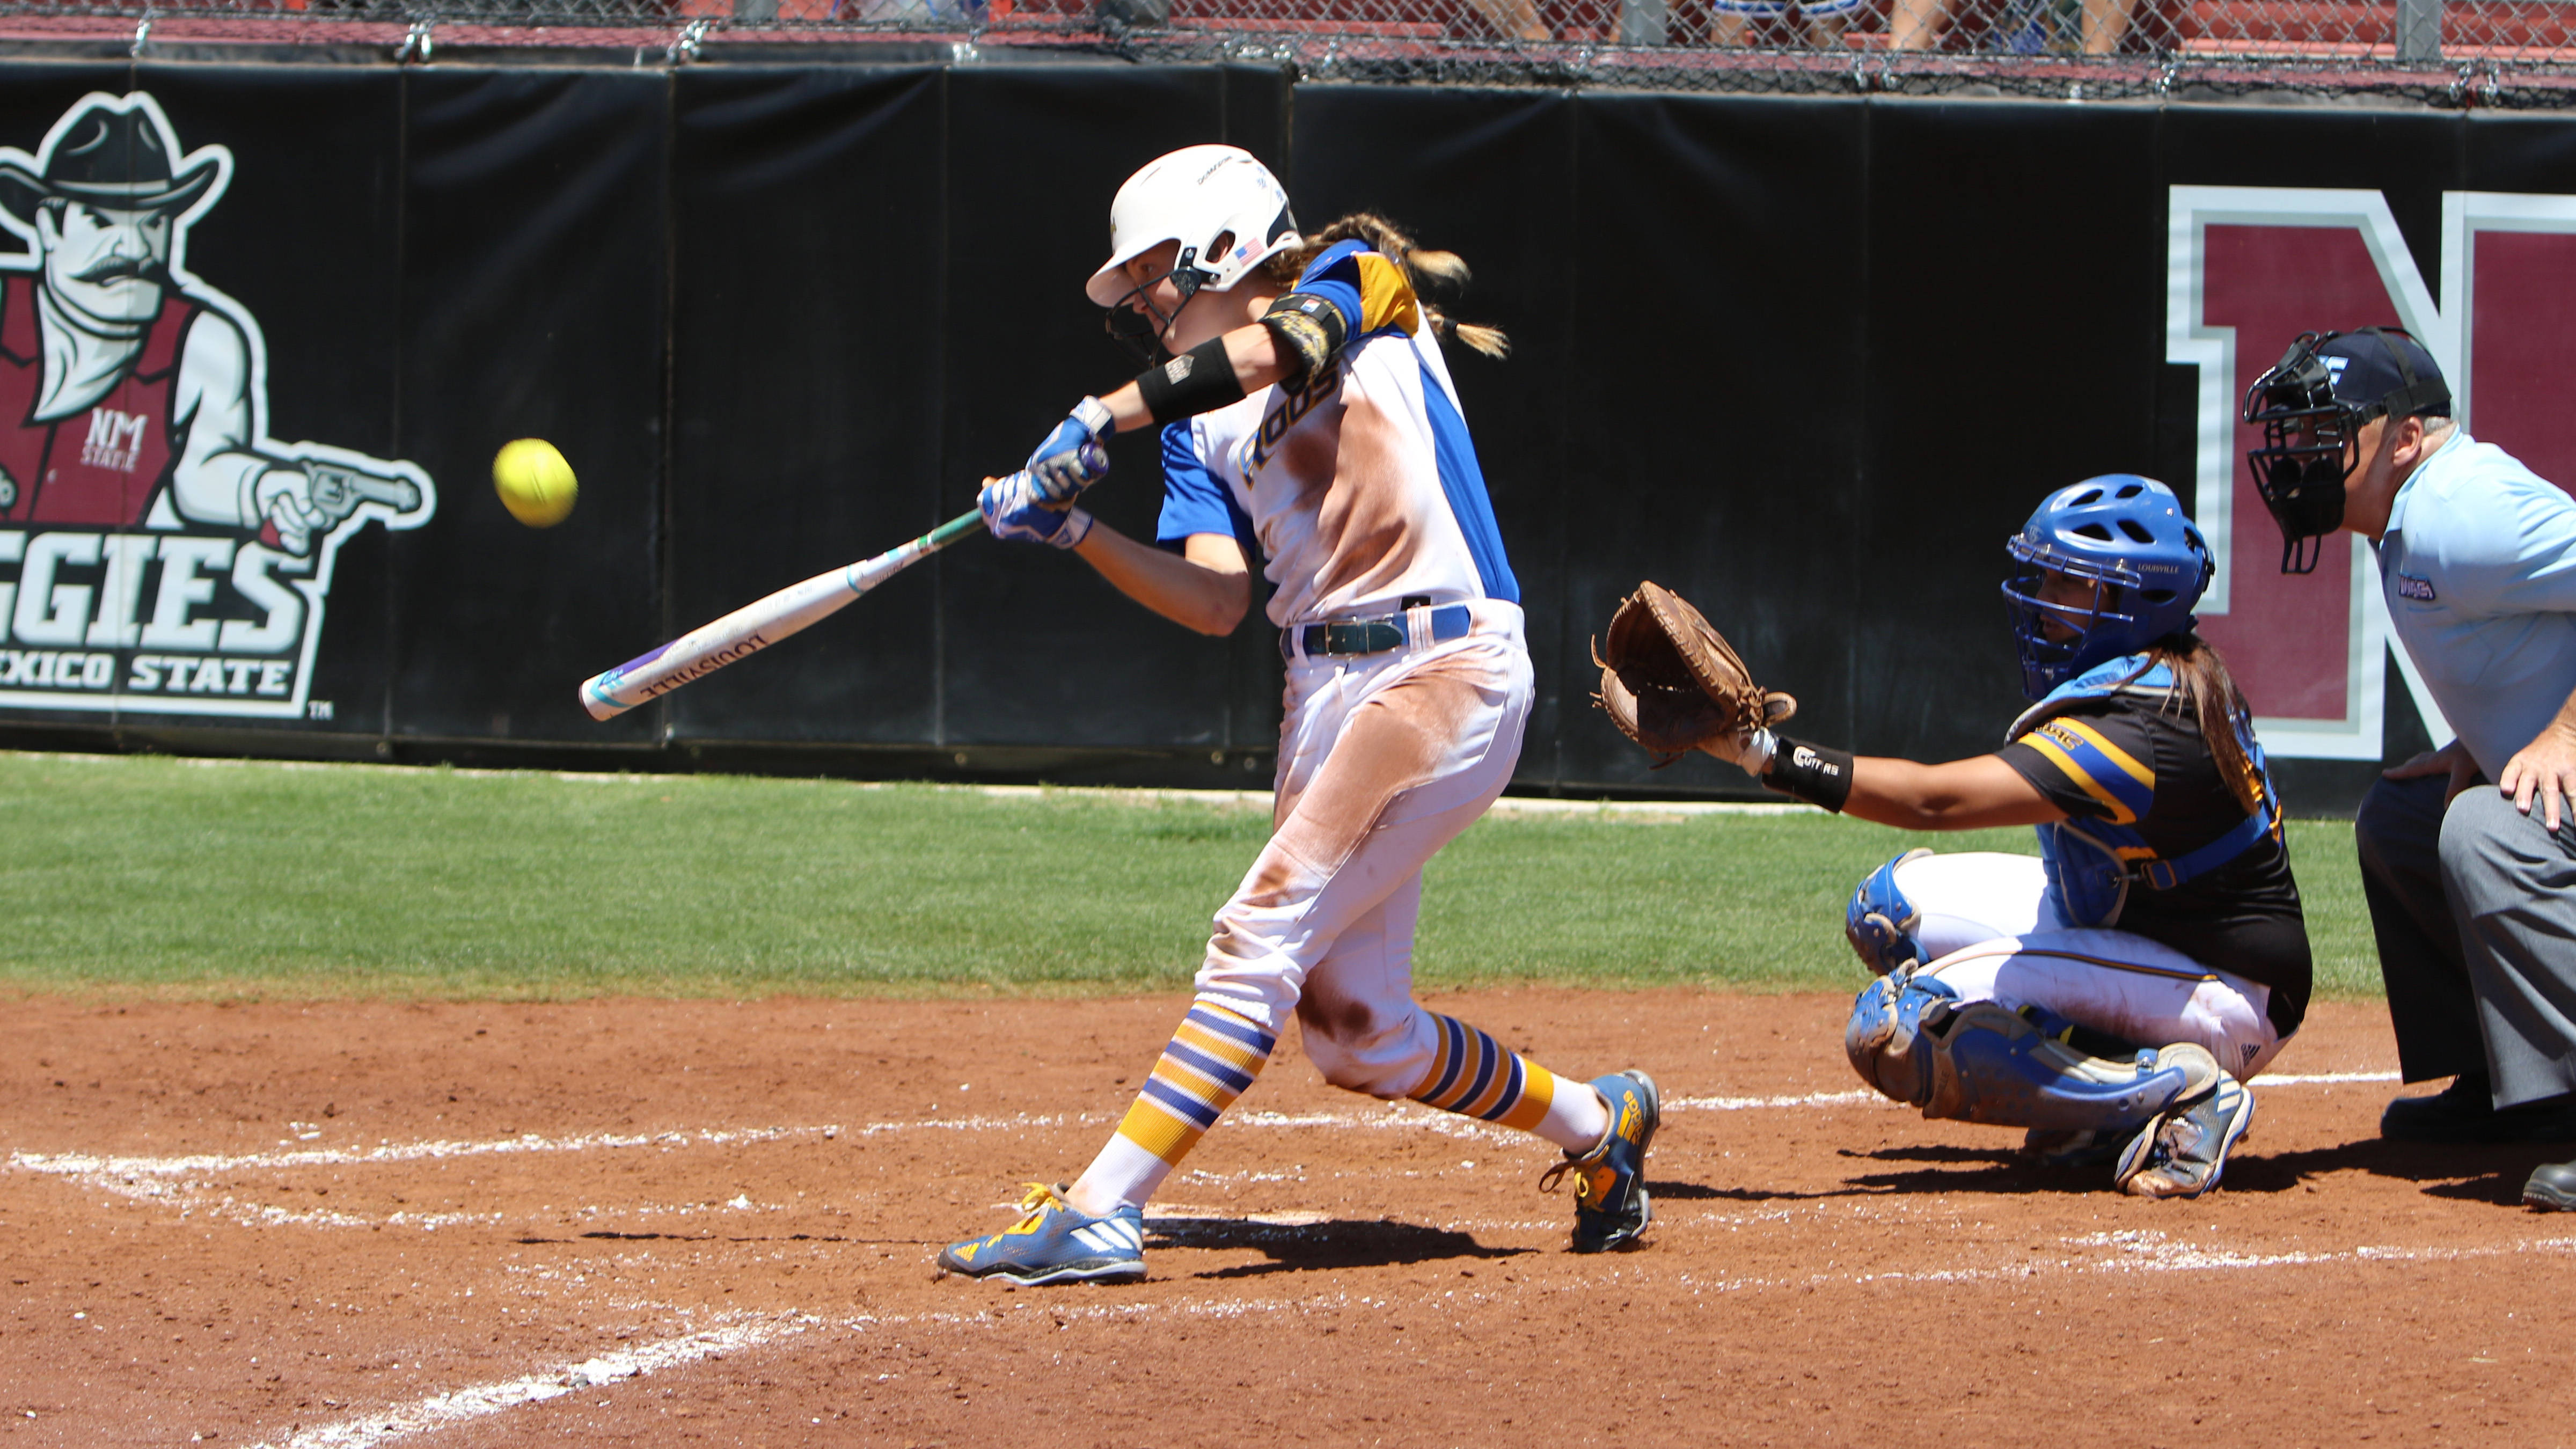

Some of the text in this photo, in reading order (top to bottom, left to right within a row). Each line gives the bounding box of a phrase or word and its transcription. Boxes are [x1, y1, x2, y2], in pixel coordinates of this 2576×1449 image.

[84, 407, 149, 453] NM
[80, 446, 137, 472] STATE
[2138, 562, 2179, 574] LOUISVILLE
[0, 650, 291, 694] XICO STATE
[640, 632, 767, 698] LOUISVILLE
